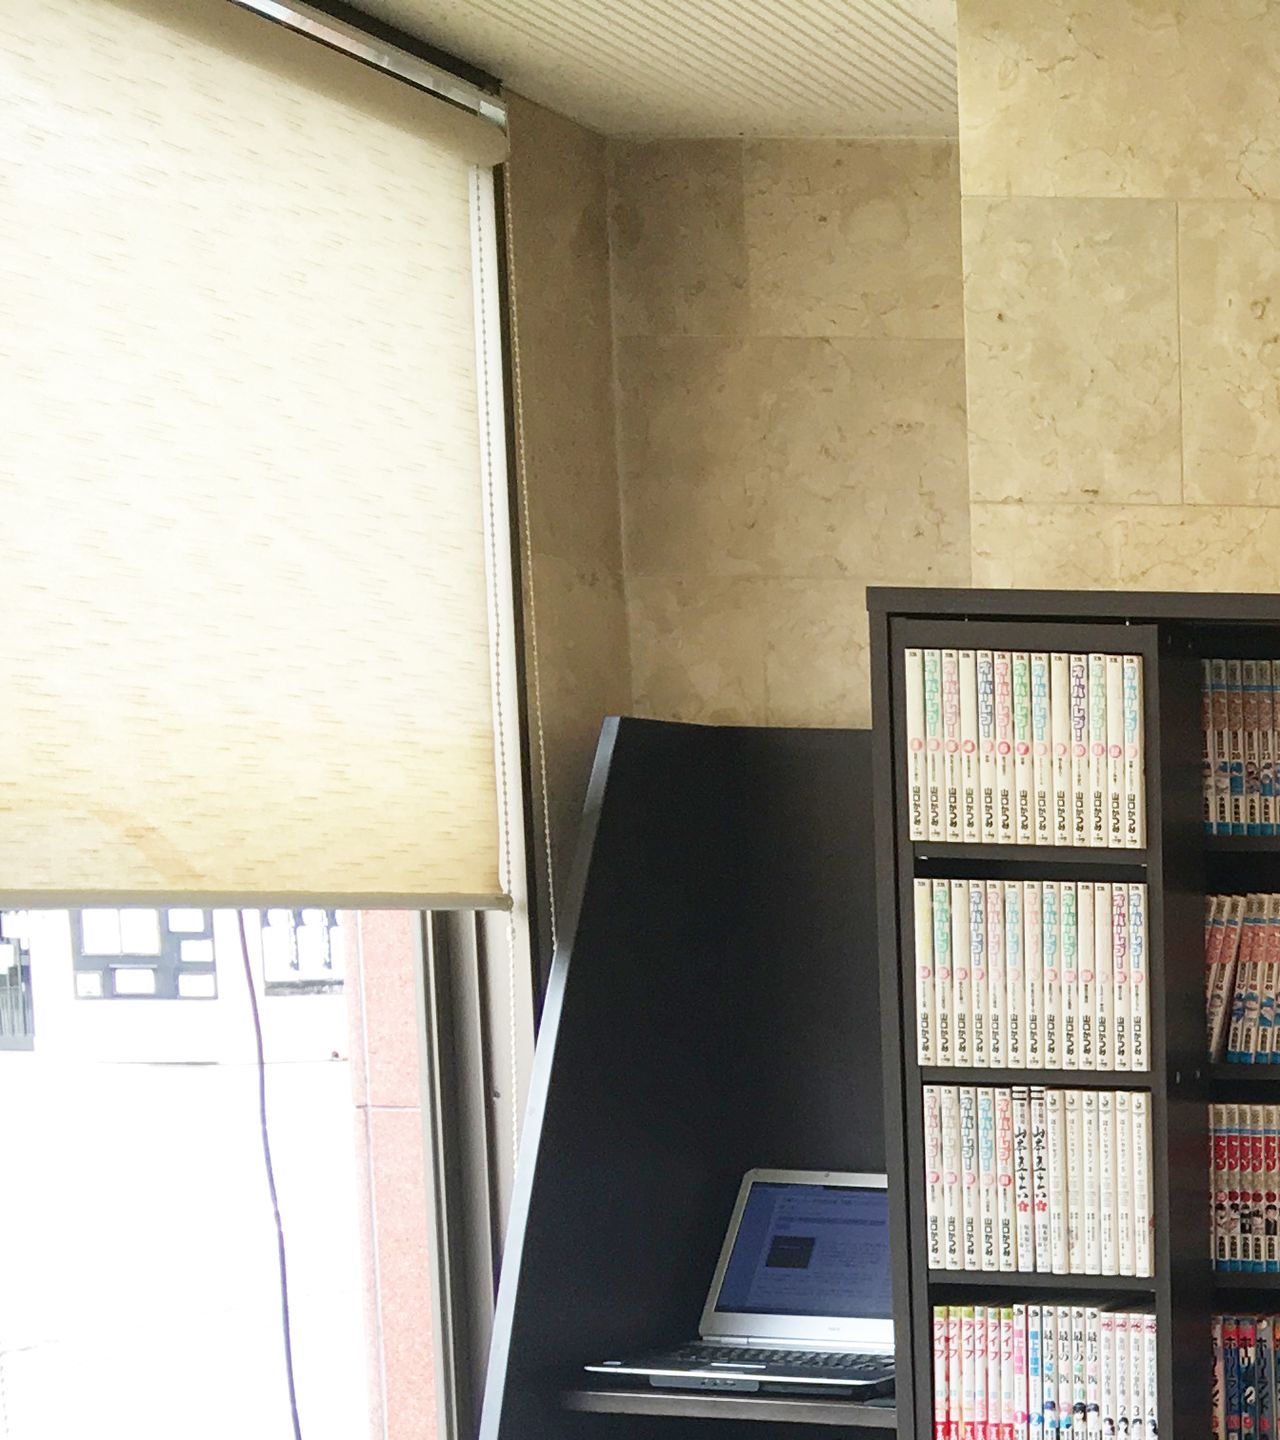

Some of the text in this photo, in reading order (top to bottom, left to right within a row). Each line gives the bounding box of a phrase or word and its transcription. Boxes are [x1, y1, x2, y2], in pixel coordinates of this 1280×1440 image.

[935, 1321, 945, 1360] ライフ
[989, 1321, 1000, 1361] ライフ
[1002, 1321, 1013, 1360] ライフ
